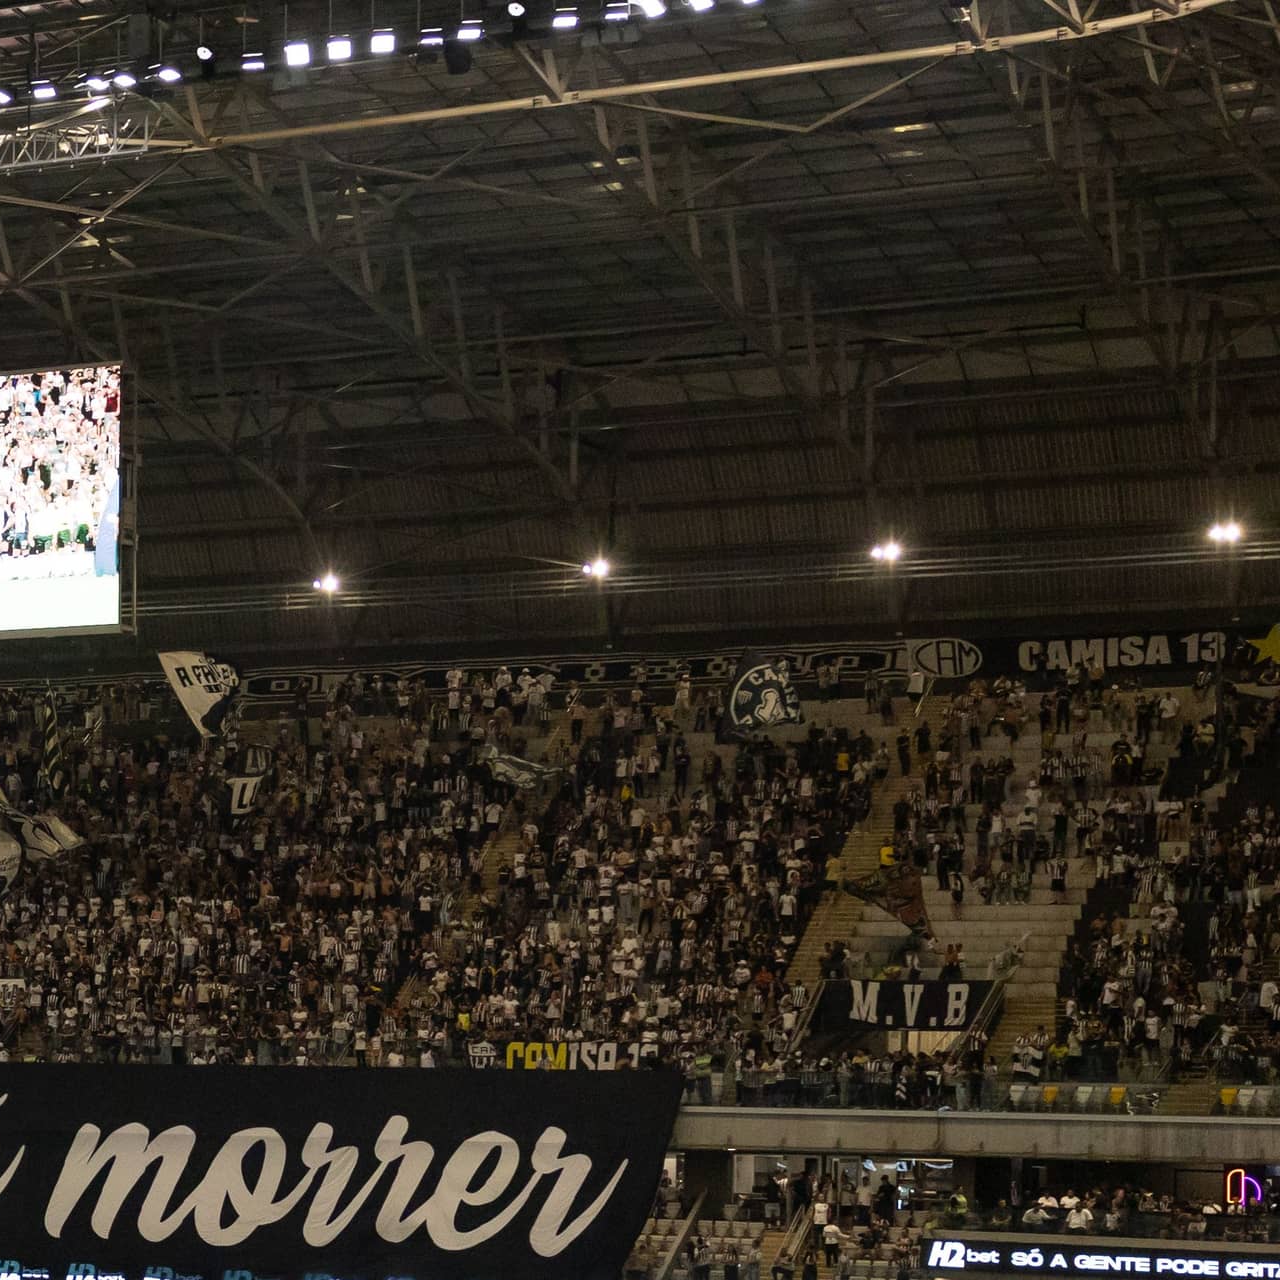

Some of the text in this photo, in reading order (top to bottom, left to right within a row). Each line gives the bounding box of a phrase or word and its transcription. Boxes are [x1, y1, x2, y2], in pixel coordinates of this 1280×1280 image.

[1018, 631, 1226, 672] CAMISA 13
[44, 1114, 628, 1258] morrer
[928, 1241, 1000, 1268] H2bet
[1011, 1247, 1044, 1267] SÓ
[1049, 1254, 1068, 1269] A
[1074, 1254, 1150, 1273] GENTE
[1156, 1258, 1219, 1275] PODE
